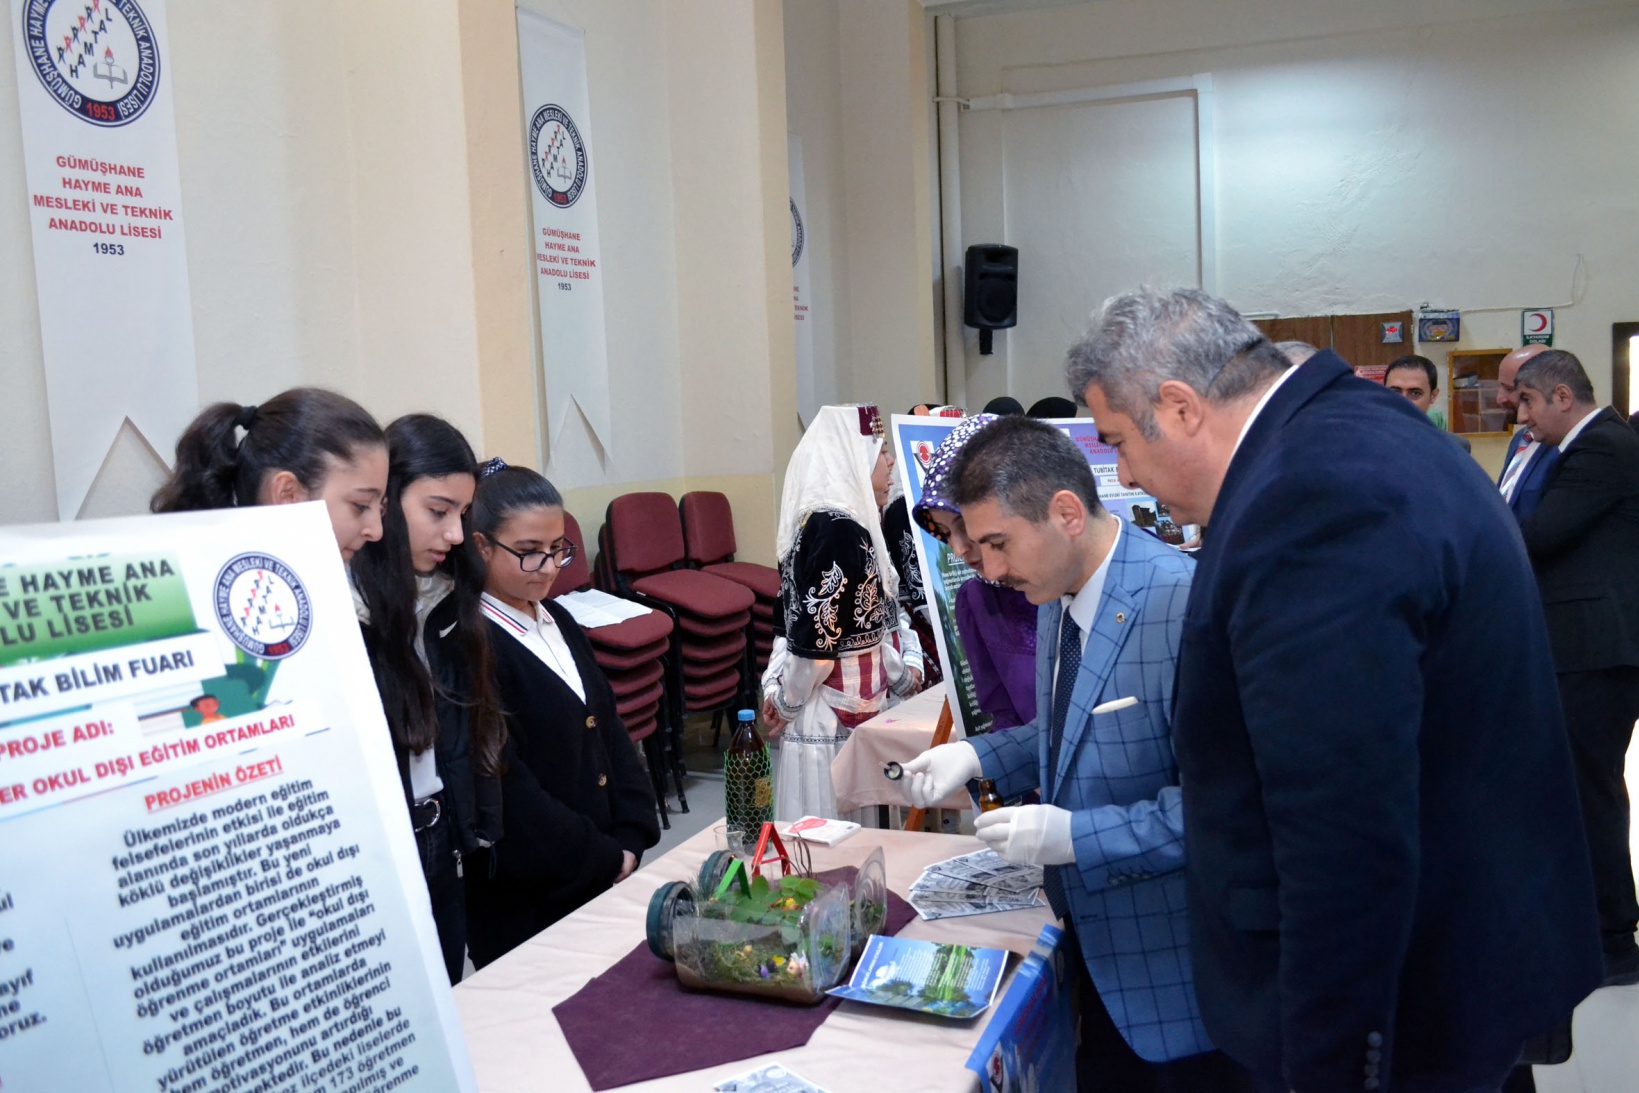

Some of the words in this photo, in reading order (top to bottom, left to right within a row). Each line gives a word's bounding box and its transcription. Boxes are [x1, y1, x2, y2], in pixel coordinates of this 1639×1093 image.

[138, 40, 154, 95] ANADOLU
[86, 102, 116, 121] 1953
[56, 155, 145, 179] GÜMÜŞHANE
[62, 177, 111, 194] HAYME
[115, 183, 143, 198] ANA
[33, 195, 96, 213] MESLEKİ
[100, 202, 118, 215] VE
[122, 205, 173, 220] TEKNİK
[48, 218, 116, 235] ANADOLU
[120, 224, 162, 239] LİSESİ
[542, 227, 581, 241] GÜMÜŞHANE
[93, 242, 125, 256] 1953
[540, 267, 568, 278] ANADOLU
[569, 268, 590, 280] LİSESİ
[545, 241, 566, 252] HAYME
[567, 243, 580, 253] ANA
[561, 256, 569, 265] VE
[570, 256, 596, 267] TEKNİK
[557, 282, 572, 291] 1953
[2, 598, 42, 620] VE
[50, 581, 152, 615] TEKNİK
[20, 565, 114, 594] HAYME
[125, 559, 175, 582] ANA
[47, 604, 134, 639] LİSESİ
[55, 662, 123, 693] BİLİM
[128, 649, 195, 679] FUARI
[32, 767, 91, 796] OKUL
[95, 755, 135, 778] DIŞI
[139, 738, 200, 767] EĞİTİM
[204, 713, 295, 751] ORTAMLARI
[73, 720, 114, 744] ADI:
[144, 771, 233, 811] PROJENİN
[235, 754, 283, 782] ÖZETİ
[112, 827, 218, 871] felsefelerinin
[223, 809, 263, 835] etkisi
[267, 804, 284, 820] ile
[288, 789, 329, 814] eğitim
[123, 811, 208, 849] Ülkemizde
[212, 793, 268, 821] modern
[271, 778, 313, 803] eğitim
[117, 854, 189, 889] alanında
[193, 845, 221, 862] son
[224, 821, 278, 855] yıllarda
[282, 804, 334, 833] oldukça
[118, 879, 165, 908] köklü
[170, 847, 262, 886] değişiklikler
[265, 818, 341, 858] yaşanmaya
[113, 892, 242, 949] uygulamalardan
[245, 871, 283, 896] birisi
[286, 863, 303, 880] de
[306, 850, 335, 873] okul
[337, 842, 360, 863] dışı
[167, 868, 258, 908] başlamıştır.
[260, 857, 280, 874] Bu
[283, 843, 312, 868] yeni
[130, 922, 254, 982] kullanılmasıdır.
[256, 874, 364, 928] Gerçekleştirmiş
[180, 913, 229, 943] eğitim
[233, 877, 320, 919] ortamlarının
[133, 954, 223, 1000] olduğumuz
[225, 943, 245, 960] bu
[248, 925, 286, 952] proje
[288, 914, 306, 932] ile
[347, 889, 370, 908] dışı
[137, 977, 210, 1018] öğrenme
[291, 902, 376, 949] uygulamaları
[142, 1009, 223, 1056] öğretmen
[225, 983, 276, 1016] boyutu
[279, 972, 298, 989] ile
[301, 953, 341, 979] analiz
[344, 927, 387, 958] etmeyi
[169, 1007, 190, 1022] ve
[194, 955, 298, 1013] çalışmalarının
[301, 924, 361, 961] etkilerini
[157, 1041, 236, 1092] yürütülen
[239, 1007, 299, 1048] öğretme
[302, 961, 392, 1014] etkinliklerinin
[183, 1007, 267, 1057] amaçladık.
[269, 996, 290, 1013] Bu
[292, 957, 368, 1001] ortamlarda
[211, 1035, 288, 1080] öğretmen,
[289, 1015, 320, 1039] hem
[323, 1003, 340, 1021] de
[343, 976, 391, 1012] öğrenci
[310, 1047, 330, 1064] Bu
[333, 1017, 384, 1052] nedenle
[386, 1006, 402, 1022] bu
[320, 1005, 374, 1041] artırdığı
[301, 1049, 355, 1087] ilçedeki
[356, 1019, 411, 1055] liselerde
[330, 1066, 355, 1088] 173
[357, 1032, 416, 1074] öğretmen
[389, 1057, 404, 1070] ve
